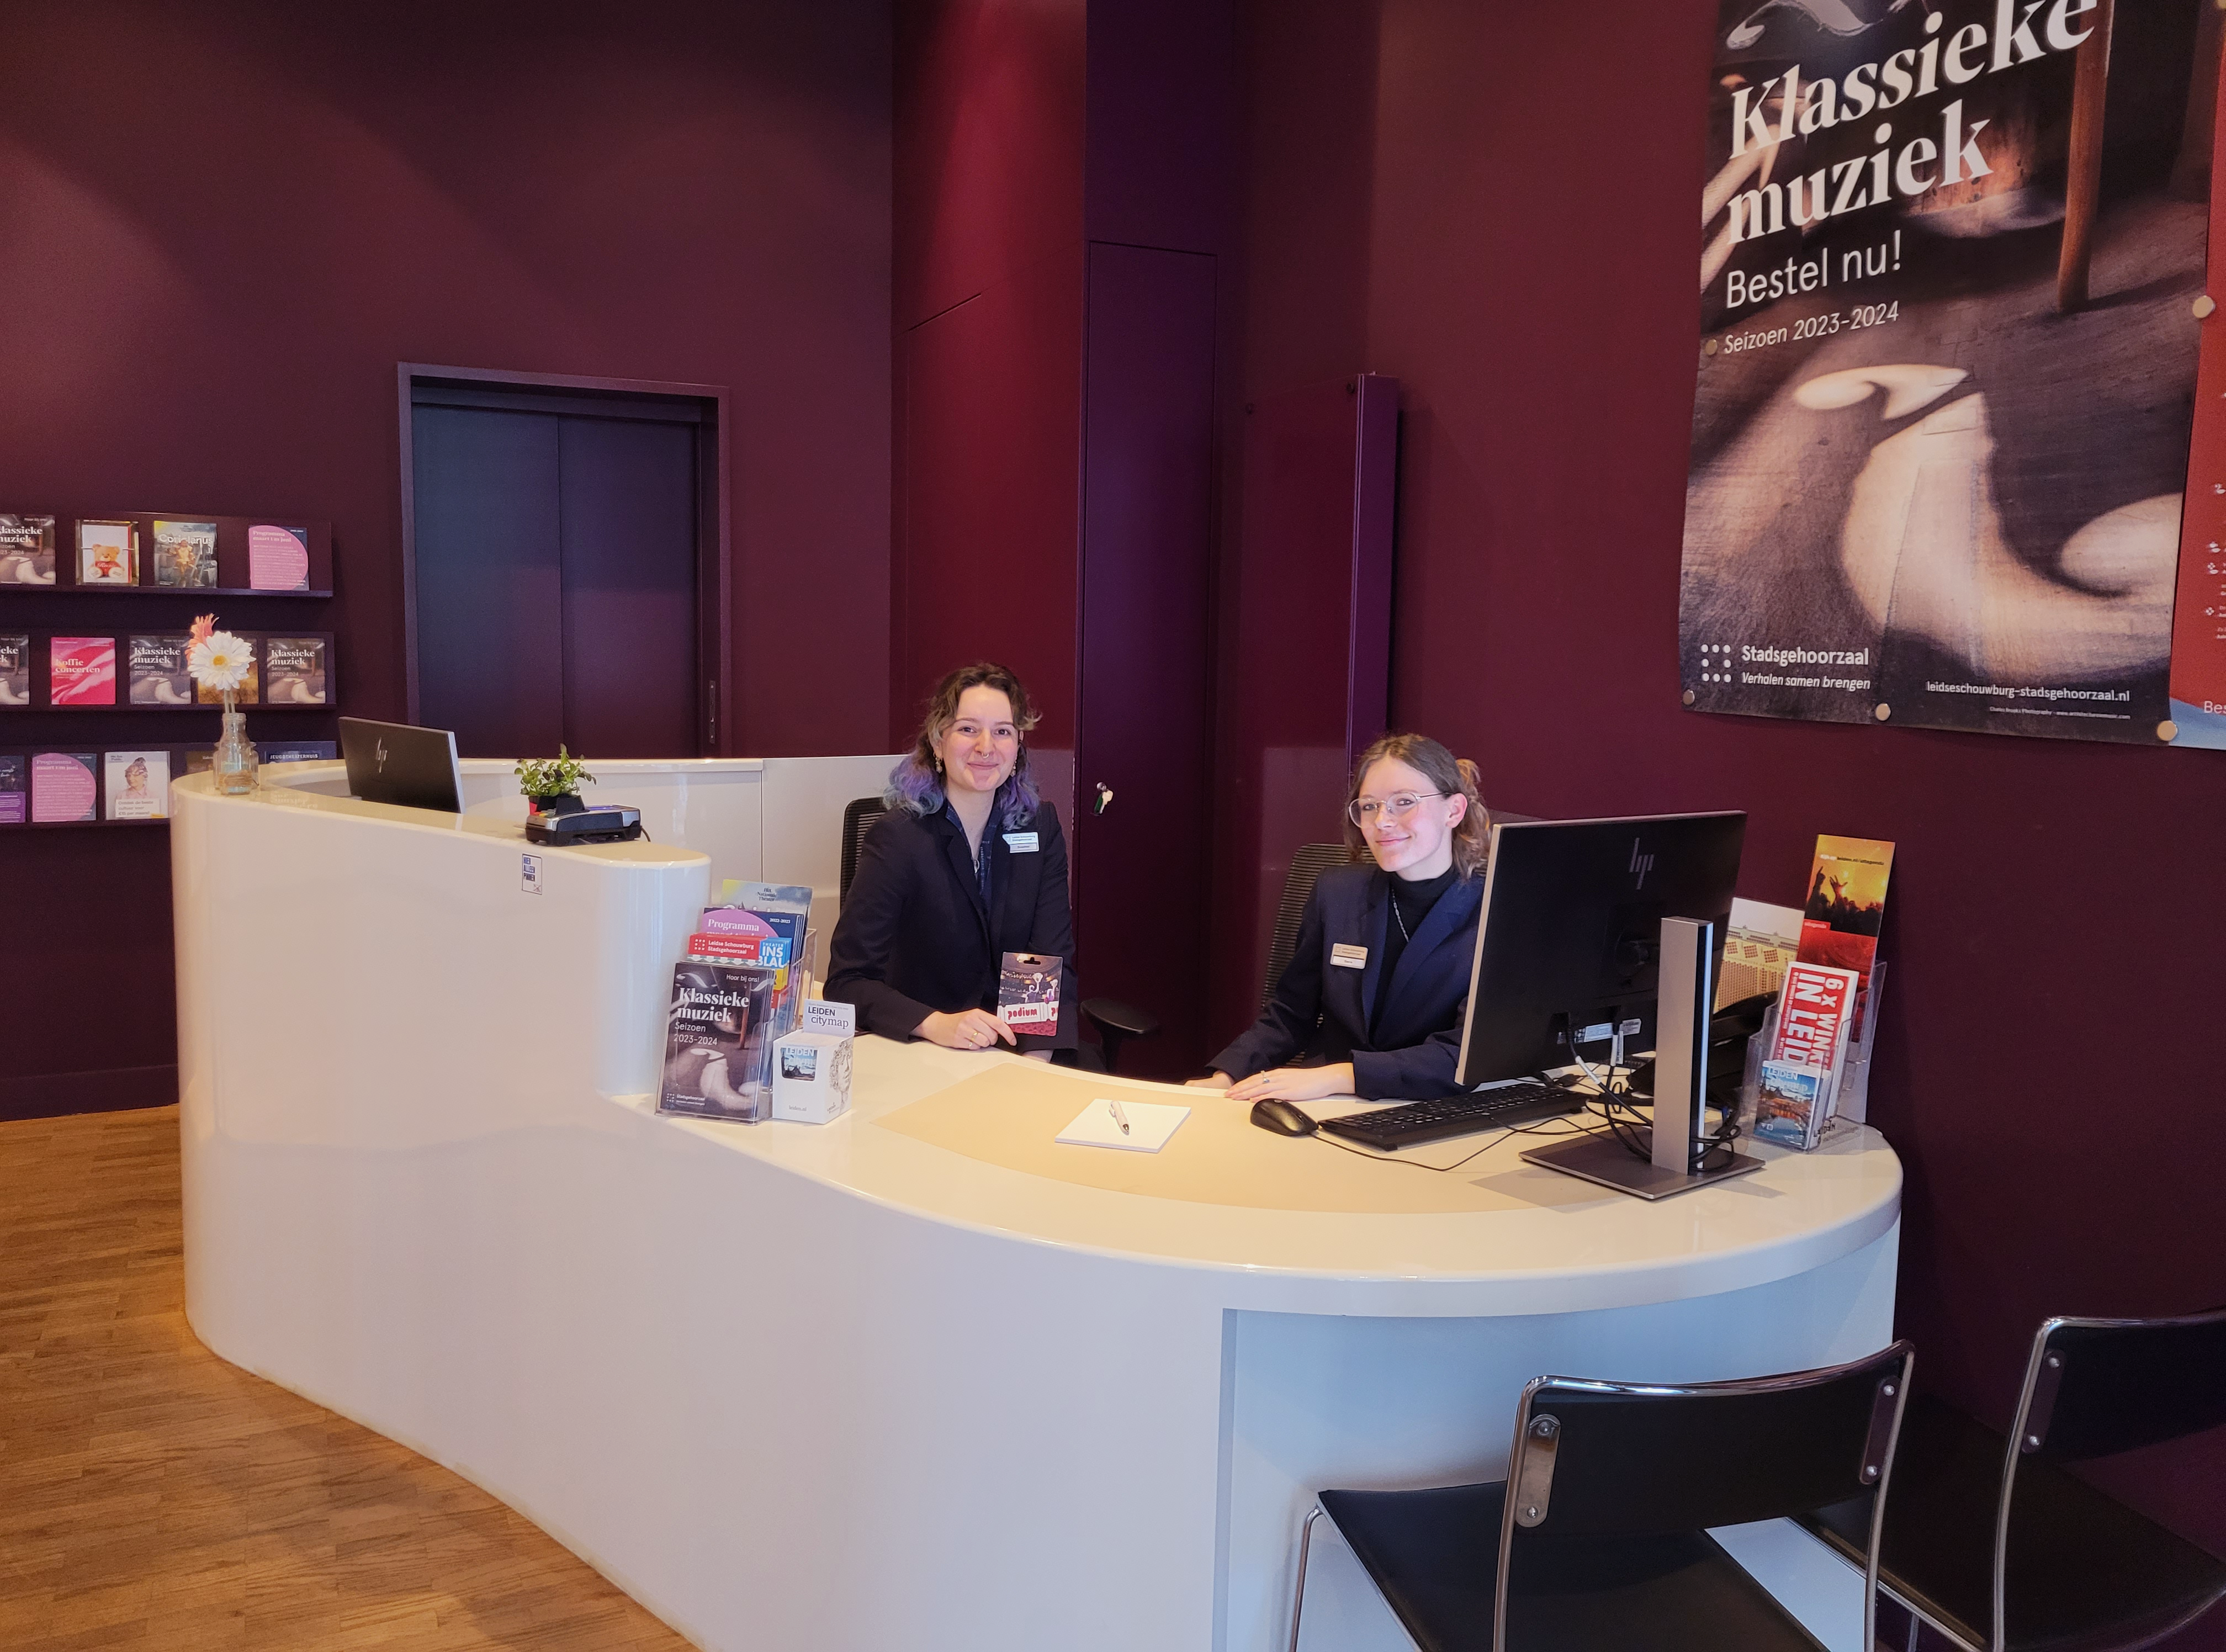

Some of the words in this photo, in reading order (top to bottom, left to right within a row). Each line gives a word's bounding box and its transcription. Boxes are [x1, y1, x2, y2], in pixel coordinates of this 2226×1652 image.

[1729, 0, 2097, 160] Klassieke
[1727, 99, 1994, 245] muziek
[1727, 247, 1827, 308] Bestel
[1843, 230, 1901, 282] nu!
[1724, 327, 1788, 354] Seizoen
[1793, 300, 1899, 341] 2023-2024
[0, 526, 43, 535] lassieke
[135, 647, 181, 656] Klassieke
[1742, 645, 1869, 667] Stadsgehoorzaal
[1742, 671, 1783, 685] Verhalen
[1785, 676, 1820, 687] samen
[1822, 675, 1871, 692] brengen
[1927, 680, 2130, 702] leidseschouwburg-stadsgehoorzaal.nl
[708, 919, 760, 931] Programma
[708, 946, 747, 954] Stadsgehoorzaal
[724, 941, 754, 950] Schouwburg
[762, 946, 783, 957] INS
[1795, 973, 1826, 1003] IN
[1826, 978, 1844, 989] 6
[679, 987, 750, 1008] Klassieke
[677, 1006, 732, 1023] muziek
[808, 1006, 835, 1016] LEIDEN
[1008, 1007, 1037, 1020] podium
[675, 1021, 706, 1032] Seizoen
[674, 1034, 718, 1045] 2023-2024
[786, 1047, 814, 1057] LEIDEN
[1768, 1067, 1798, 1081] LEIDEN
